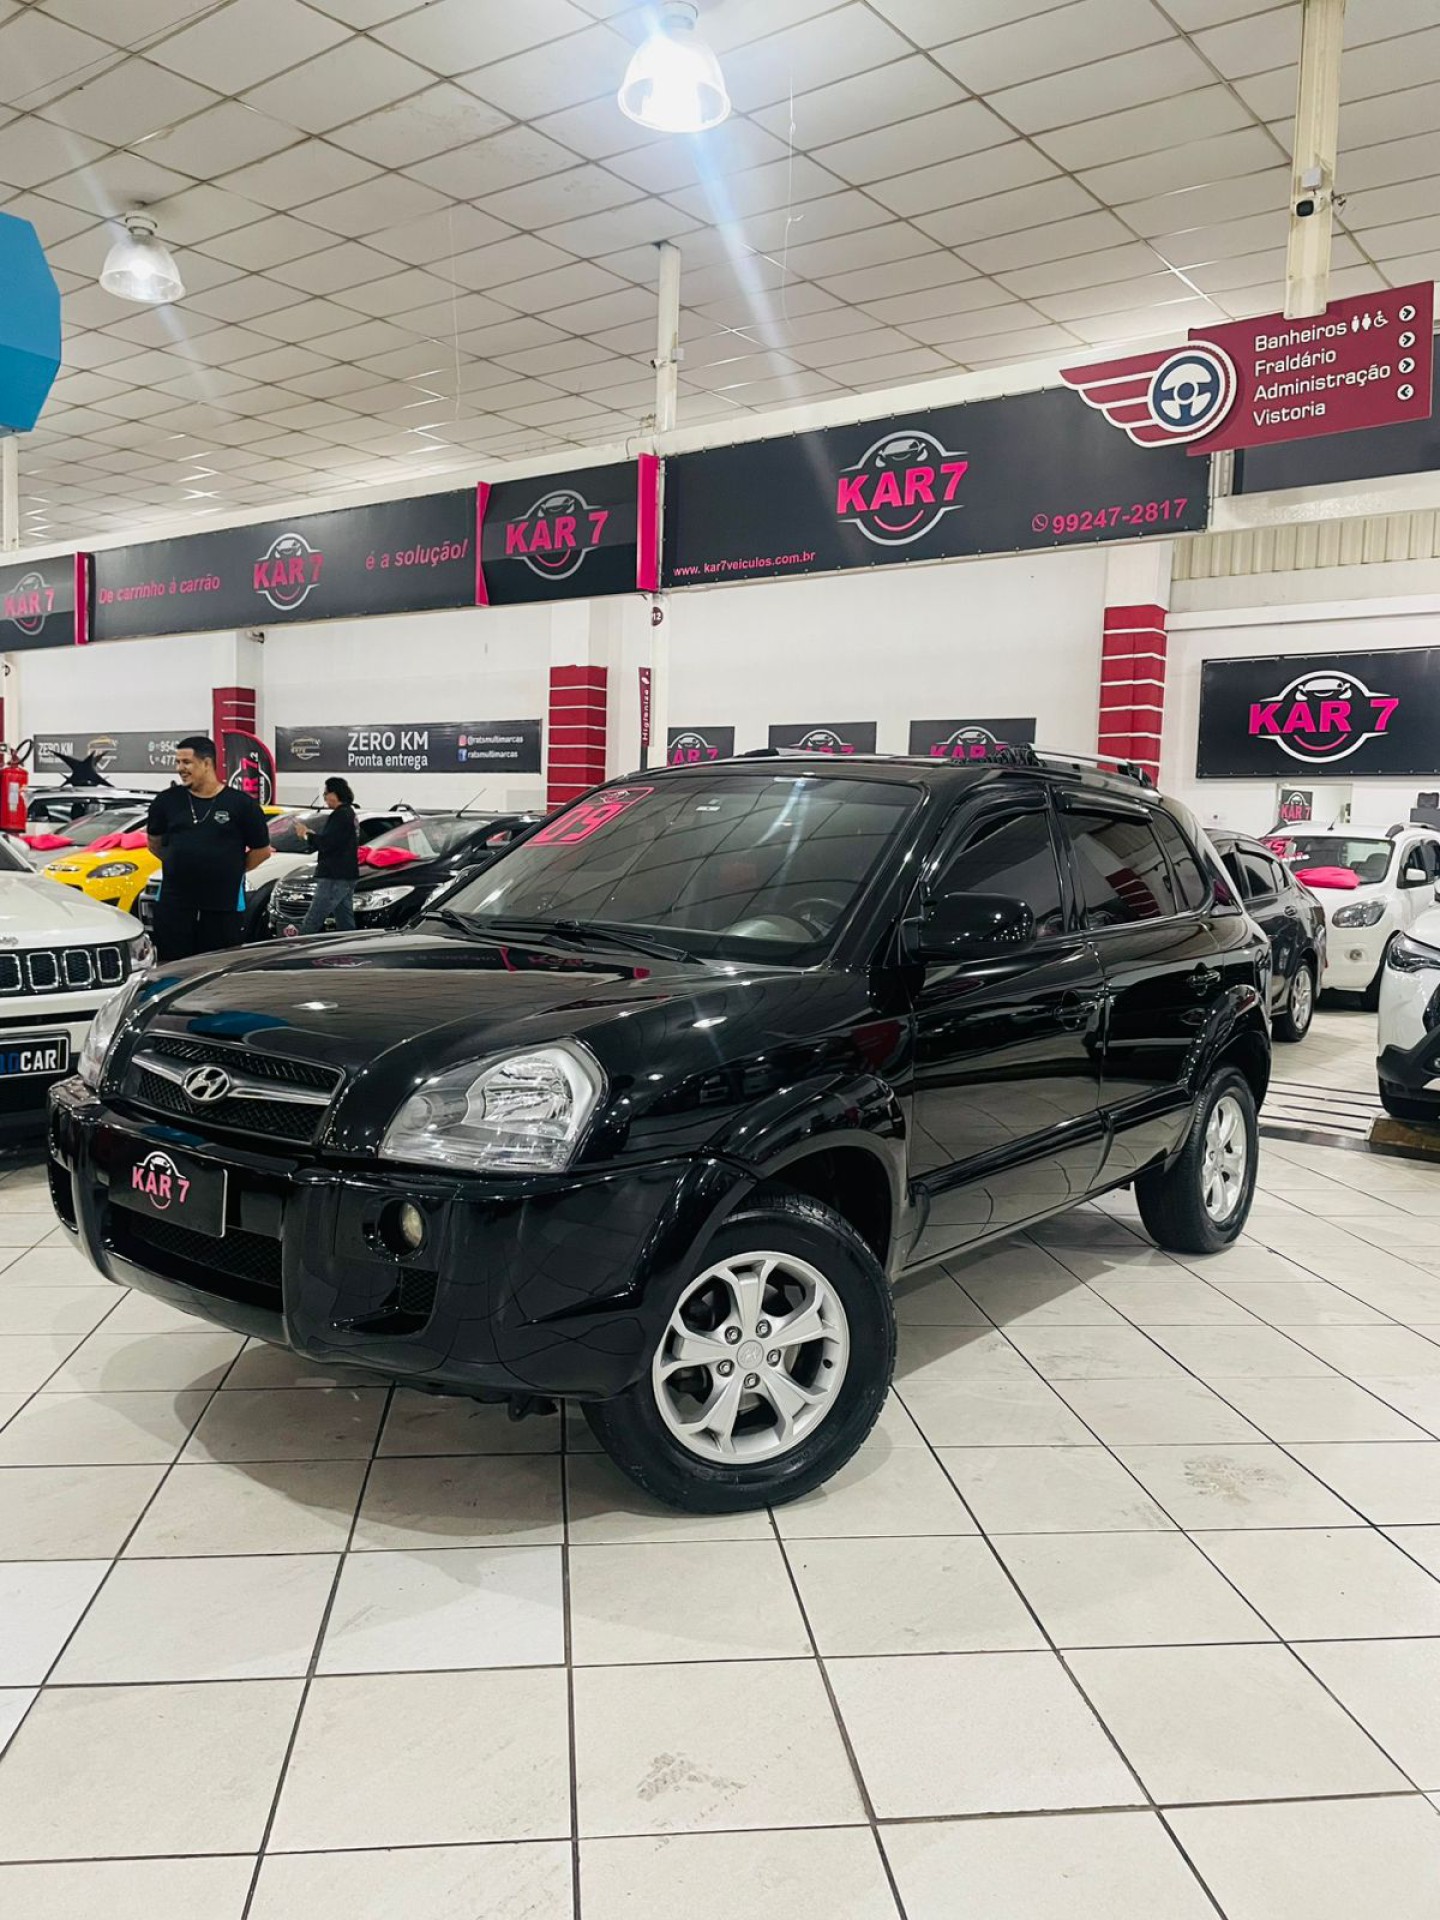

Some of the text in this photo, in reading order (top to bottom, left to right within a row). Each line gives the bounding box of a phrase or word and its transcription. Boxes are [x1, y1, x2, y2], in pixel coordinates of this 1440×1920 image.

[1254, 322, 1347, 352] Banheiros
[1254, 347, 1337, 377] Fraldário
[1253, 364, 1391, 402] Administração
[1253, 401, 1326, 426] Vistoria
[836, 461, 968, 515] KAR 7
[1052, 498, 1188, 534] 99247-2817
[505, 510, 609, 555] KAR 7
[365, 538, 469, 570] é a solução!
[672, 550, 816, 577] www. kar7veiculos.com.br
[253, 553, 324, 590] KAR 7
[3, 589, 55, 617] KAR 7
[98, 587, 113, 604] De
[117, 576, 166, 601] carrinho
[179, 572, 221, 594] carrão
[1248, 698, 1399, 735] KAR 7
[38, 742, 60, 756] ZERO
[60, 742, 74, 757] KM
[347, 731, 429, 751] ZERO KM
[347, 753, 428, 771] Pronta entrega
[532, 802, 631, 843] 09
[1280, 803, 1312, 821] KAR 7
[131, 1165, 190, 1204] KAR 7
